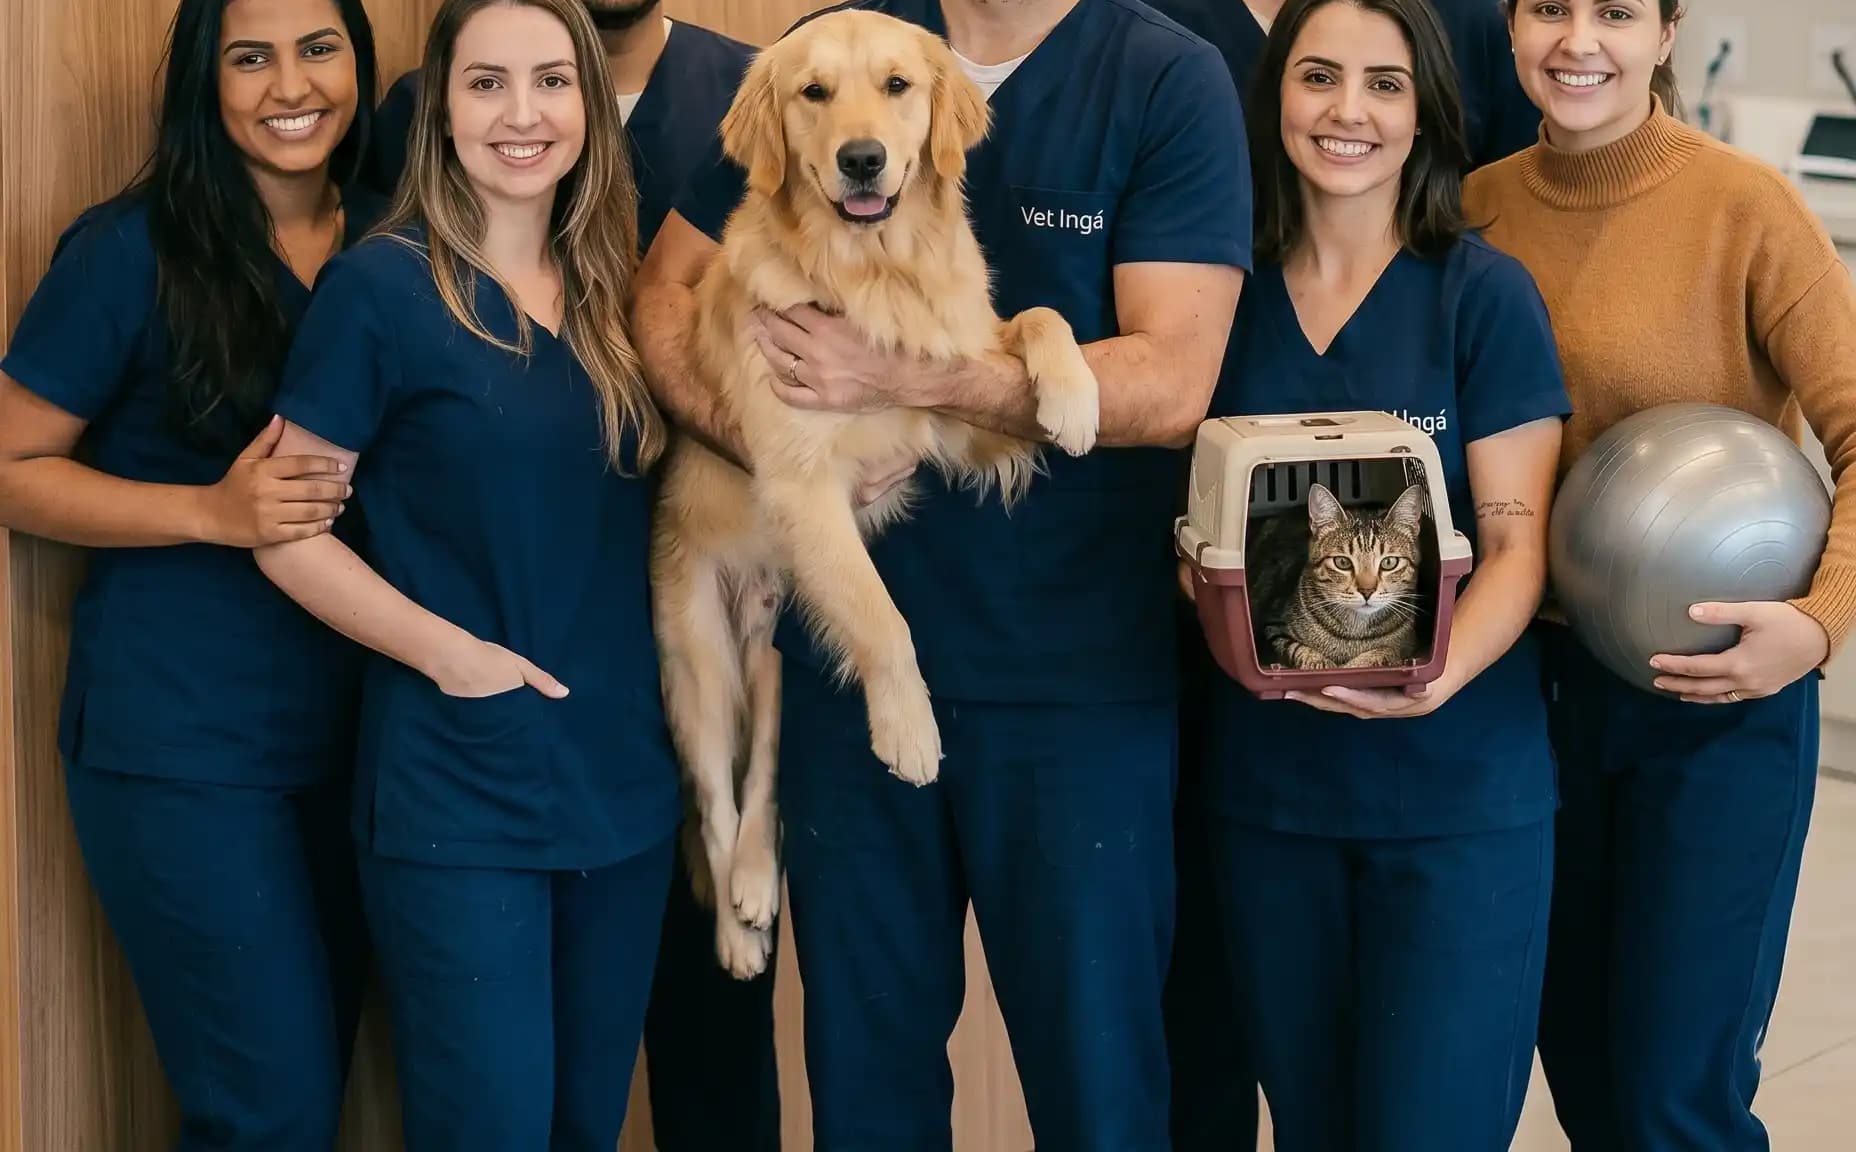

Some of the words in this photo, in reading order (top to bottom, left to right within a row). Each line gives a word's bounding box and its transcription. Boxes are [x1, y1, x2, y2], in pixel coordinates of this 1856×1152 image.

[1020, 206, 1055, 228] Vet
[1059, 208, 1104, 235] Ingá
[1402, 408, 1447, 436] Ingá
